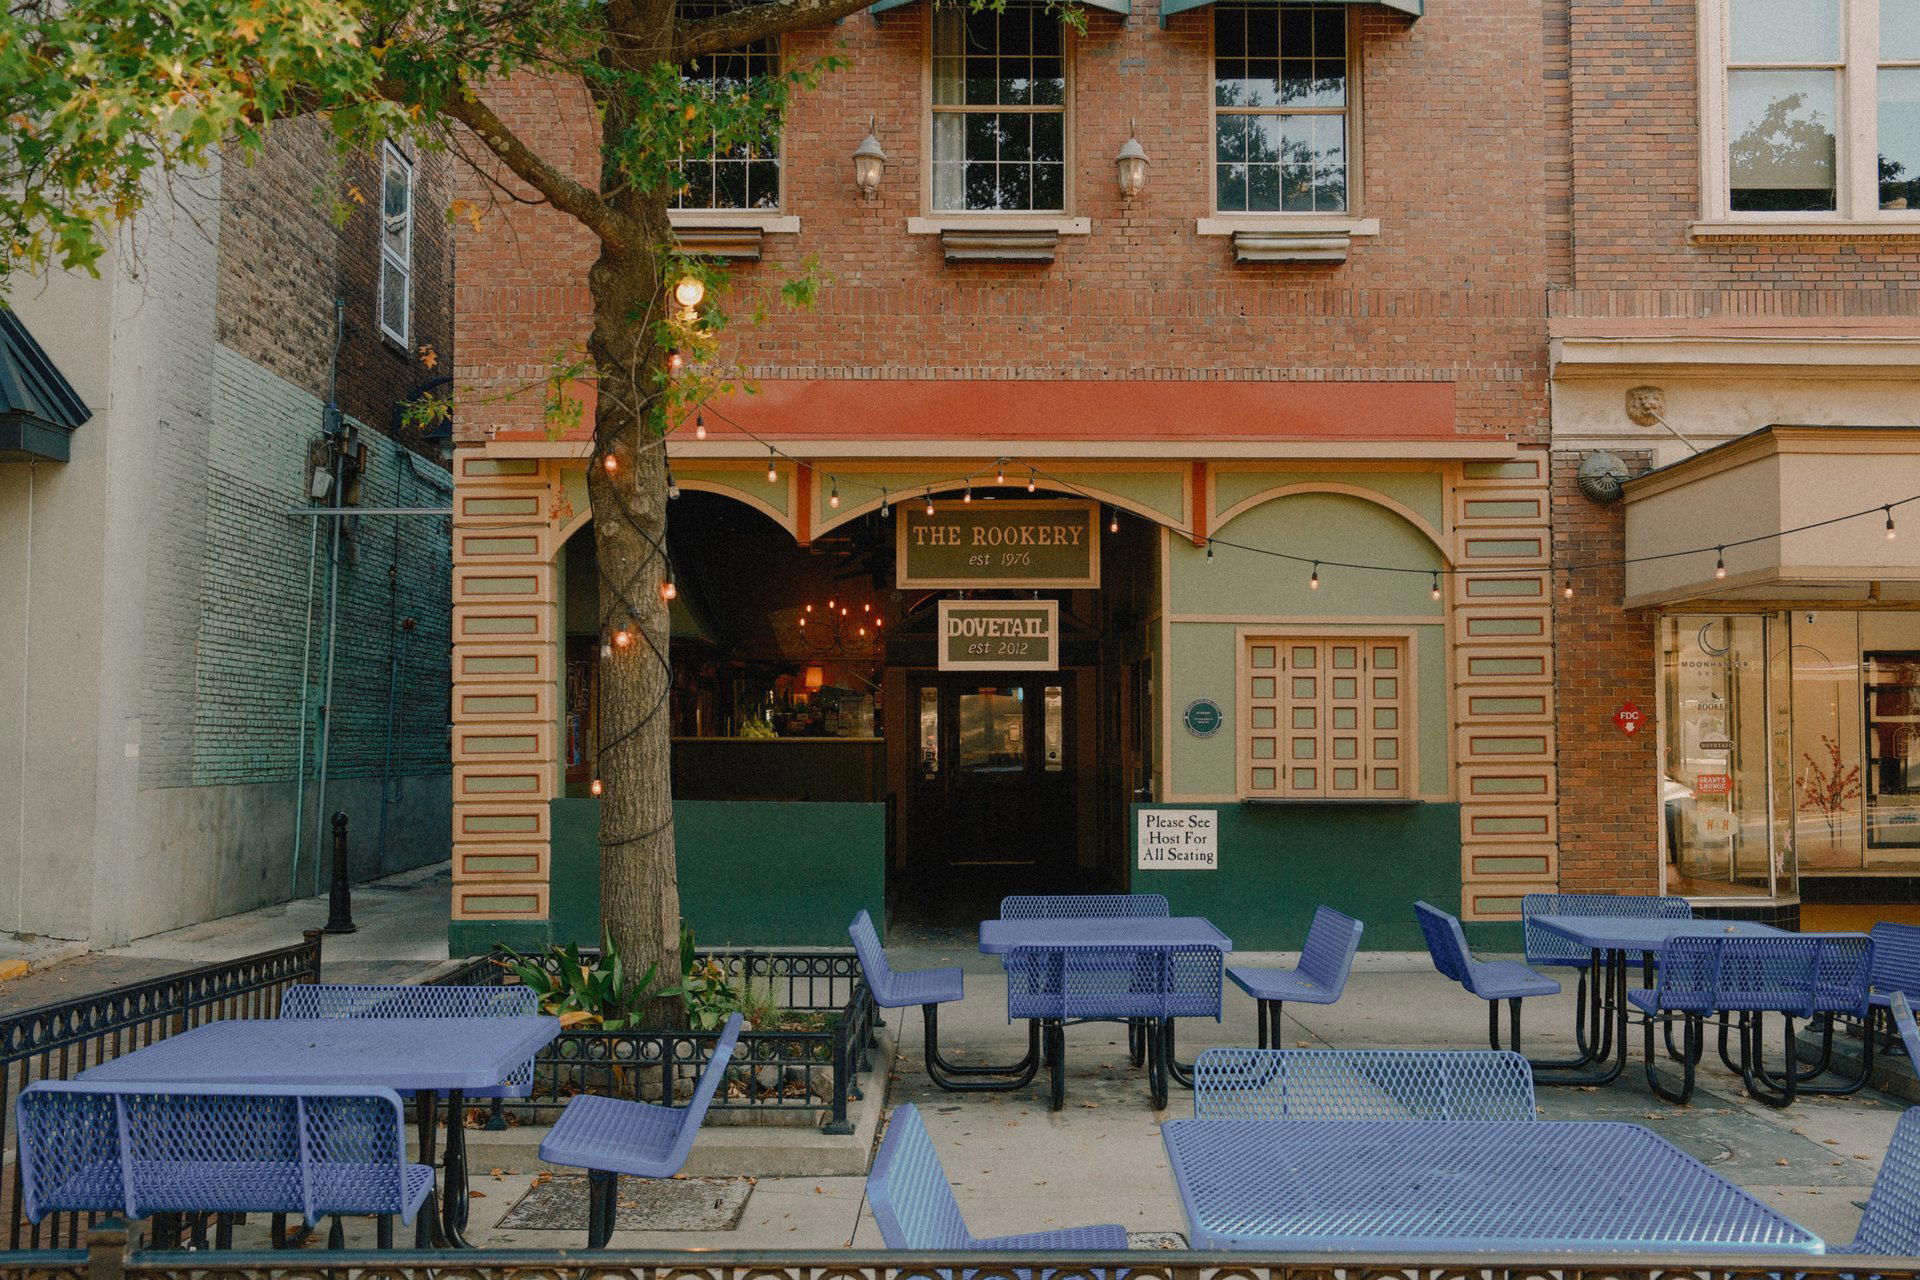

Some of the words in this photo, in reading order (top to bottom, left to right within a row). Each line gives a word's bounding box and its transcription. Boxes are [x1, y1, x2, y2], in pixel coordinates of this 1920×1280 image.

[913, 526, 961, 546] THE
[971, 526, 1084, 546] ROOKERY
[969, 553, 991, 566] est
[1001, 552, 1031, 567] 1976
[948, 617, 1049, 638] DOVETAIL
[968, 642, 991, 654] est
[997, 642, 1029, 655] 2012
[1697, 703, 1731, 711] ROOKE
[1620, 711, 1640, 720] FDC
[1146, 814, 1184, 828] Please
[1188, 814, 1211, 828] See
[1149, 831, 1180, 845] Host
[1184, 831, 1208, 845] For
[1143, 847, 1164, 861] All
[1167, 847, 1214, 864] Seating
